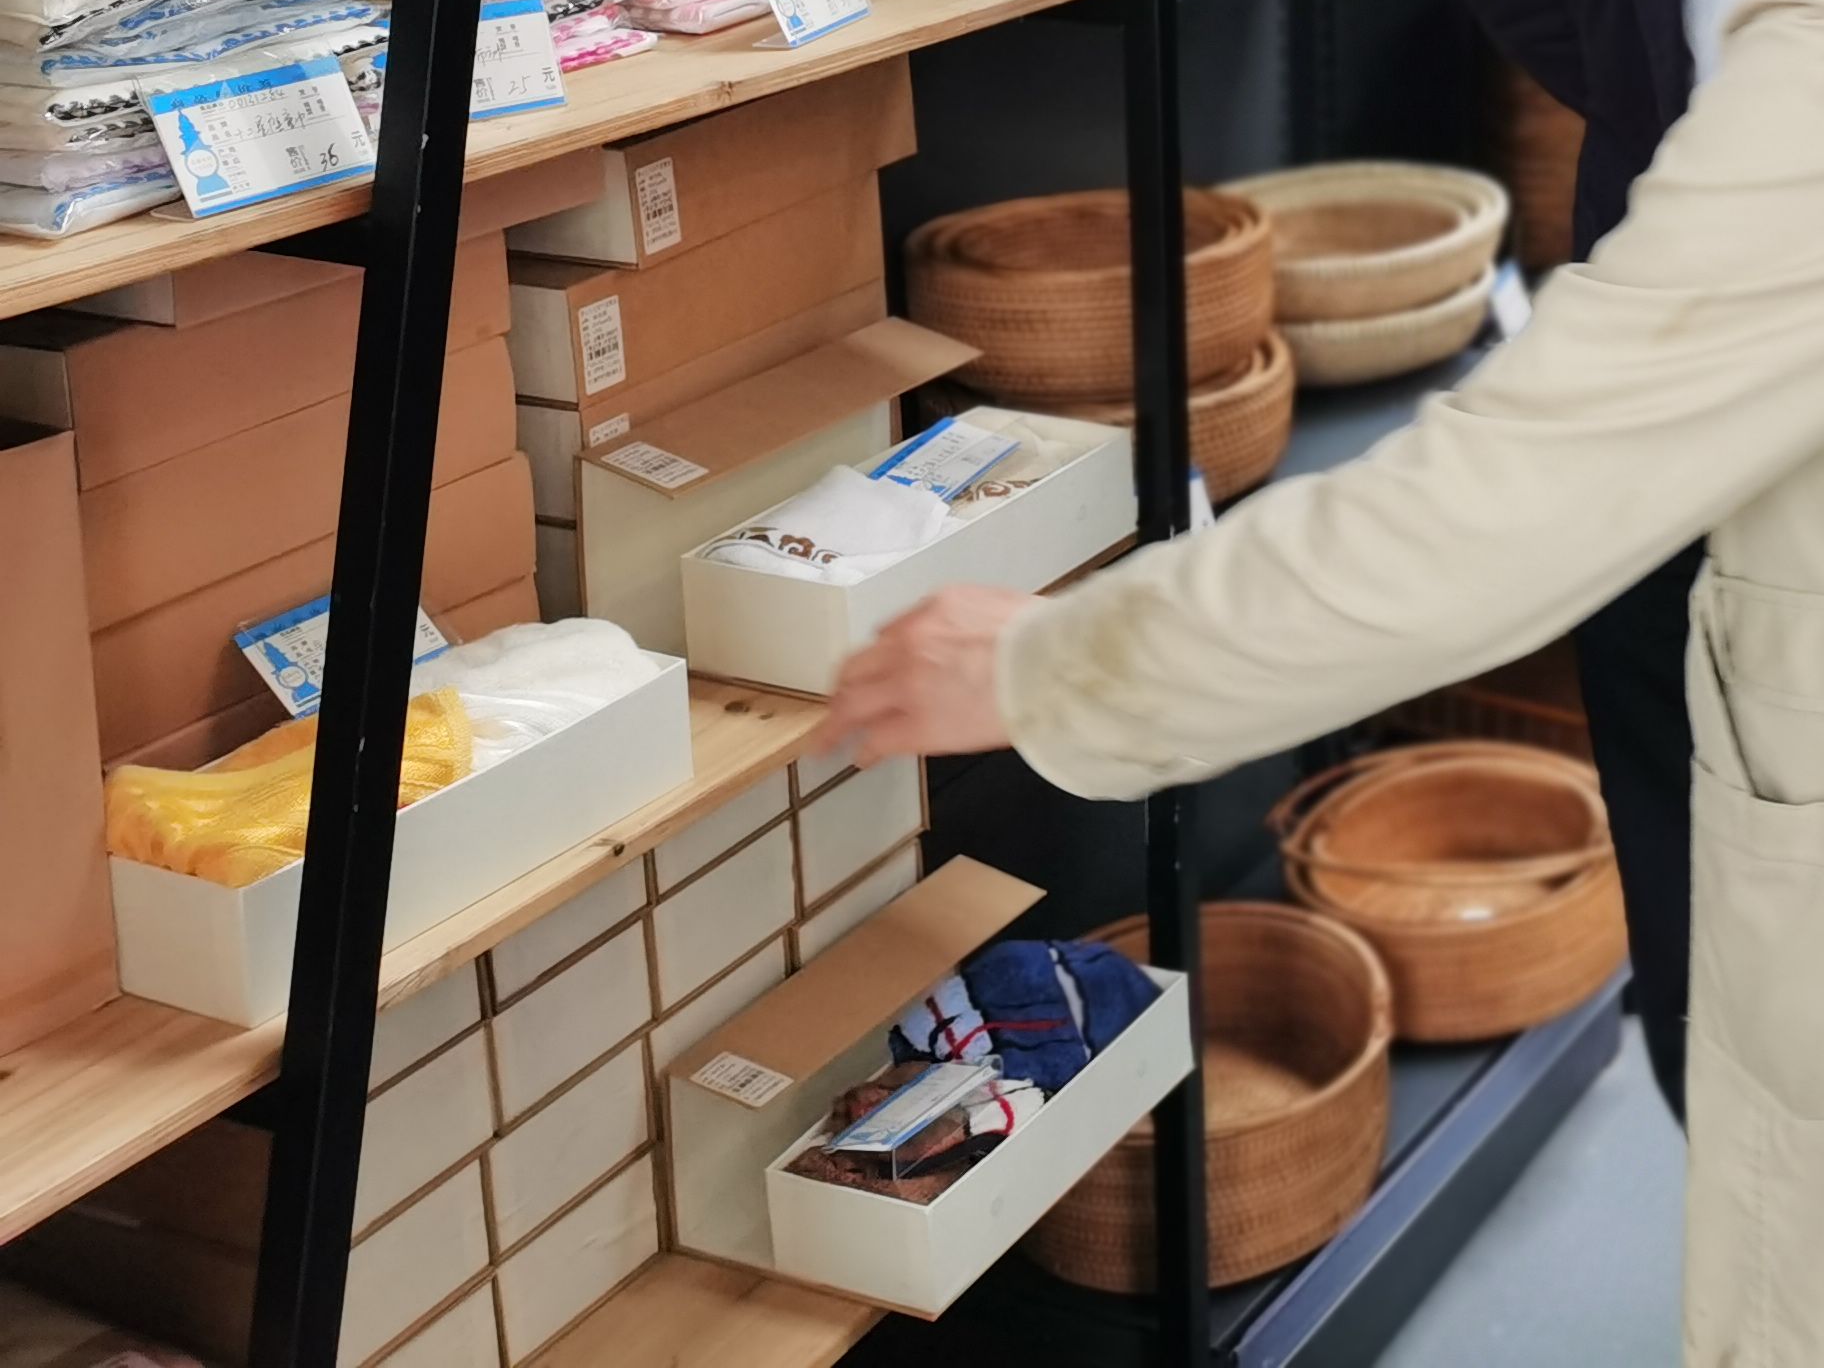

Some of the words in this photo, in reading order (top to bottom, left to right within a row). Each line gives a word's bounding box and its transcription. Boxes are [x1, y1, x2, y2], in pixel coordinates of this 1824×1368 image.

[542, 66, 556, 83] 元
[508, 75, 531, 96] 25
[352, 129, 367, 149] 元
[320, 143, 339, 172] 36
